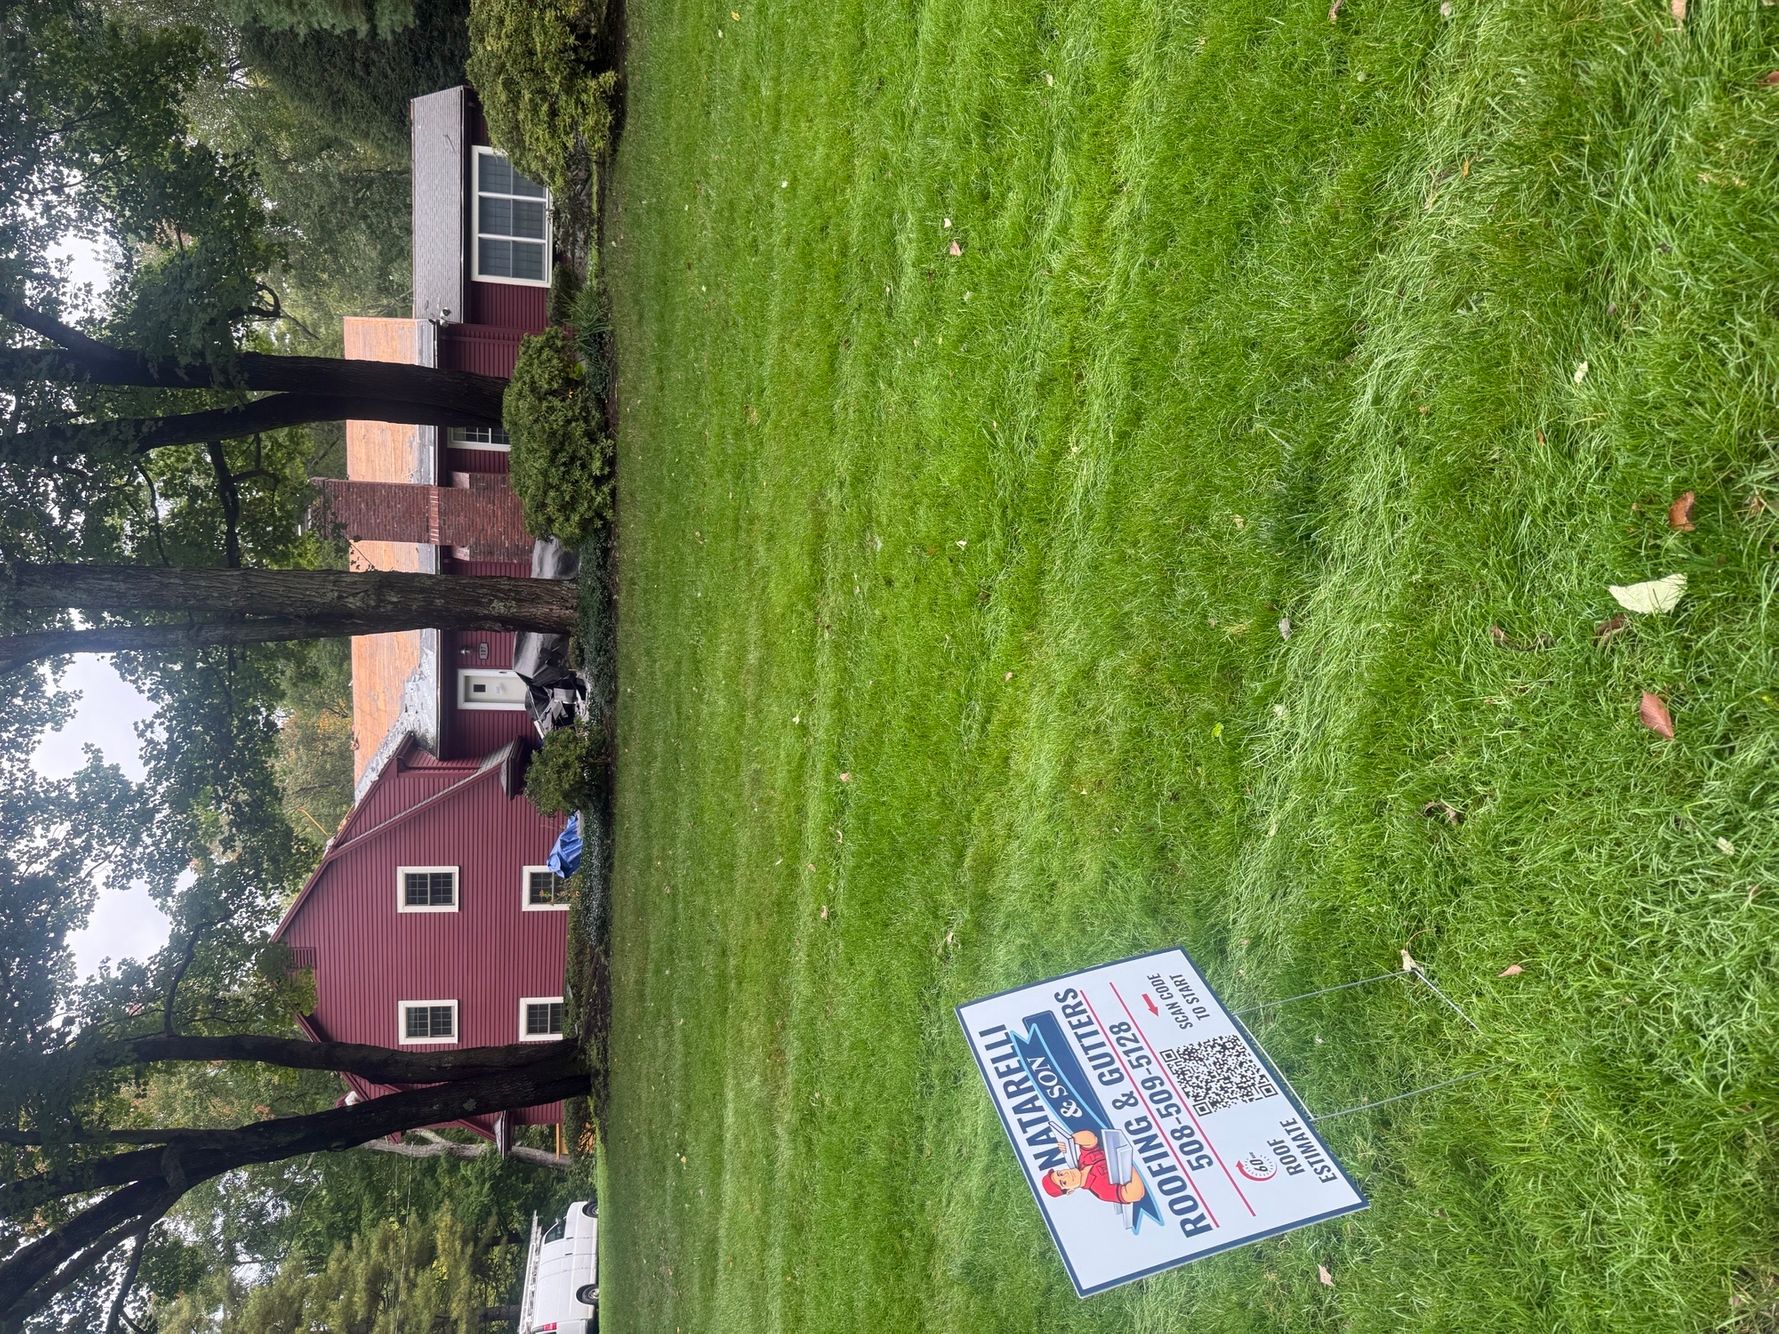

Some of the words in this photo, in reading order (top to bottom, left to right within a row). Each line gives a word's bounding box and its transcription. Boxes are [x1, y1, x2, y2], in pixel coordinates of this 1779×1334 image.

[1147, 973, 1174, 1004] CODE
[1170, 974, 1200, 1003] START
[1165, 999, 1193, 1029] SCAN
[1191, 1001, 1211, 1021] TO
[1054, 987, 1124, 1086] GUTTERS
[1027, 1056, 1068, 1101] SON
[979, 1023, 1067, 1173] NATARELLI
[1060, 1100, 1084, 1119] &
[1109, 1021, 1213, 1172] 508-509-5128
[1111, 1090, 1138, 1110] &
[1249, 1158, 1268, 1172] 60
[1267, 1139, 1306, 1175] ROOF
[1280, 1117, 1338, 1183] ESTIMATE
[1124, 1118, 1213, 1238] ROOFING
